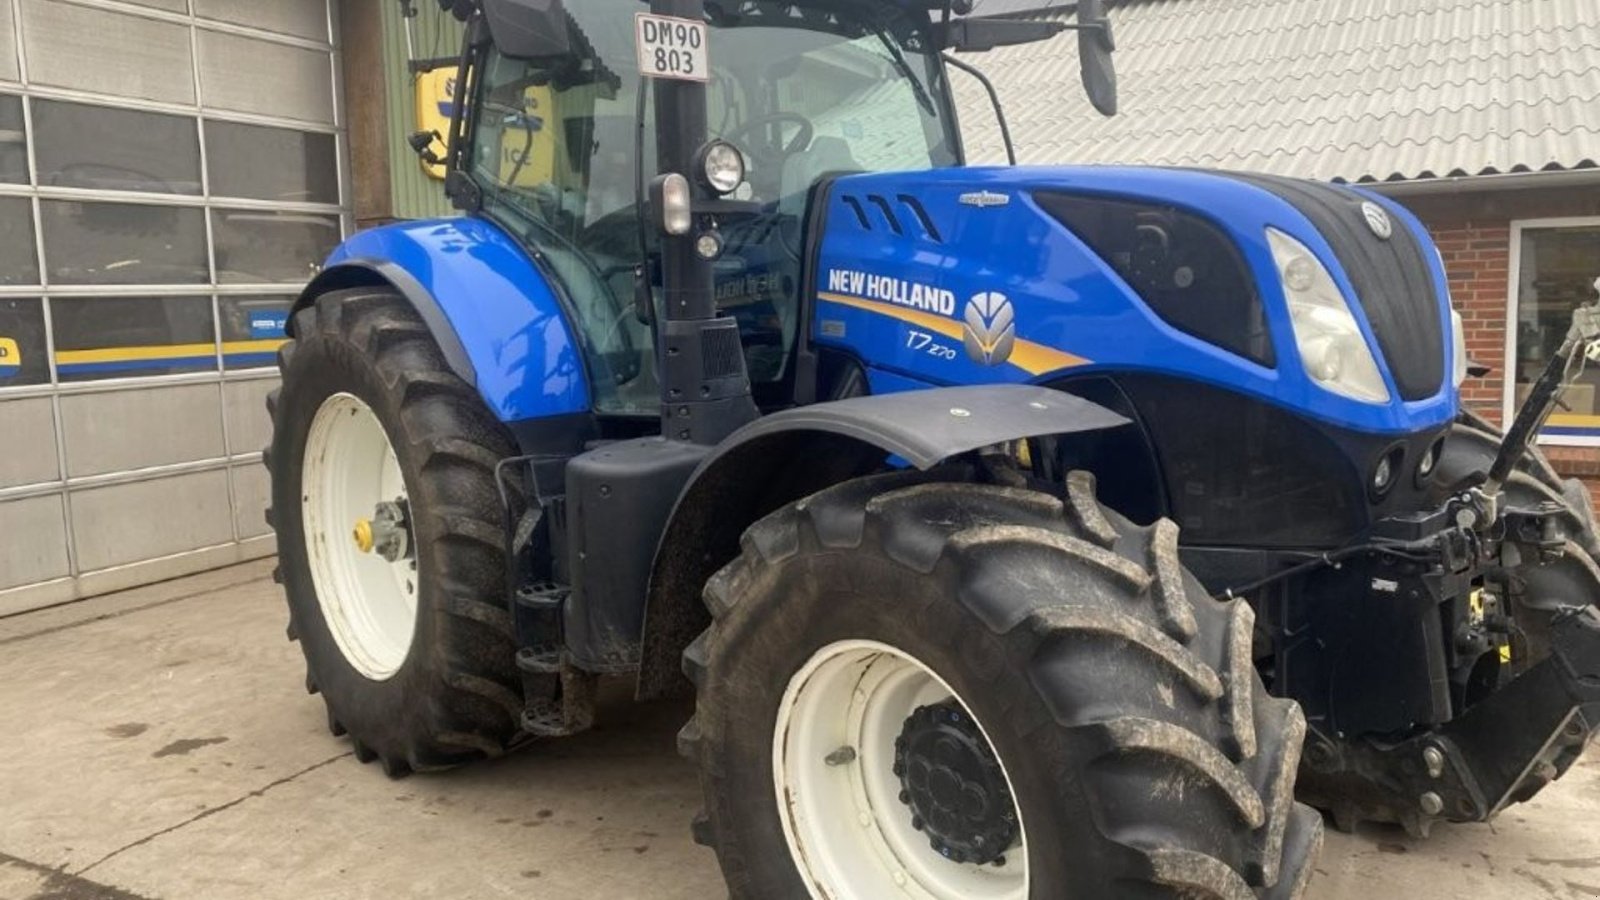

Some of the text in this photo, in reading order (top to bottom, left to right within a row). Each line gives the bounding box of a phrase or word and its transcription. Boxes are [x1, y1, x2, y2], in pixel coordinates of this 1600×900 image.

[643, 20, 701, 49] DM90
[654, 50, 694, 74] 803
[829, 268, 955, 316] NEW HOLLAND
[907, 331, 956, 360] T7 270
